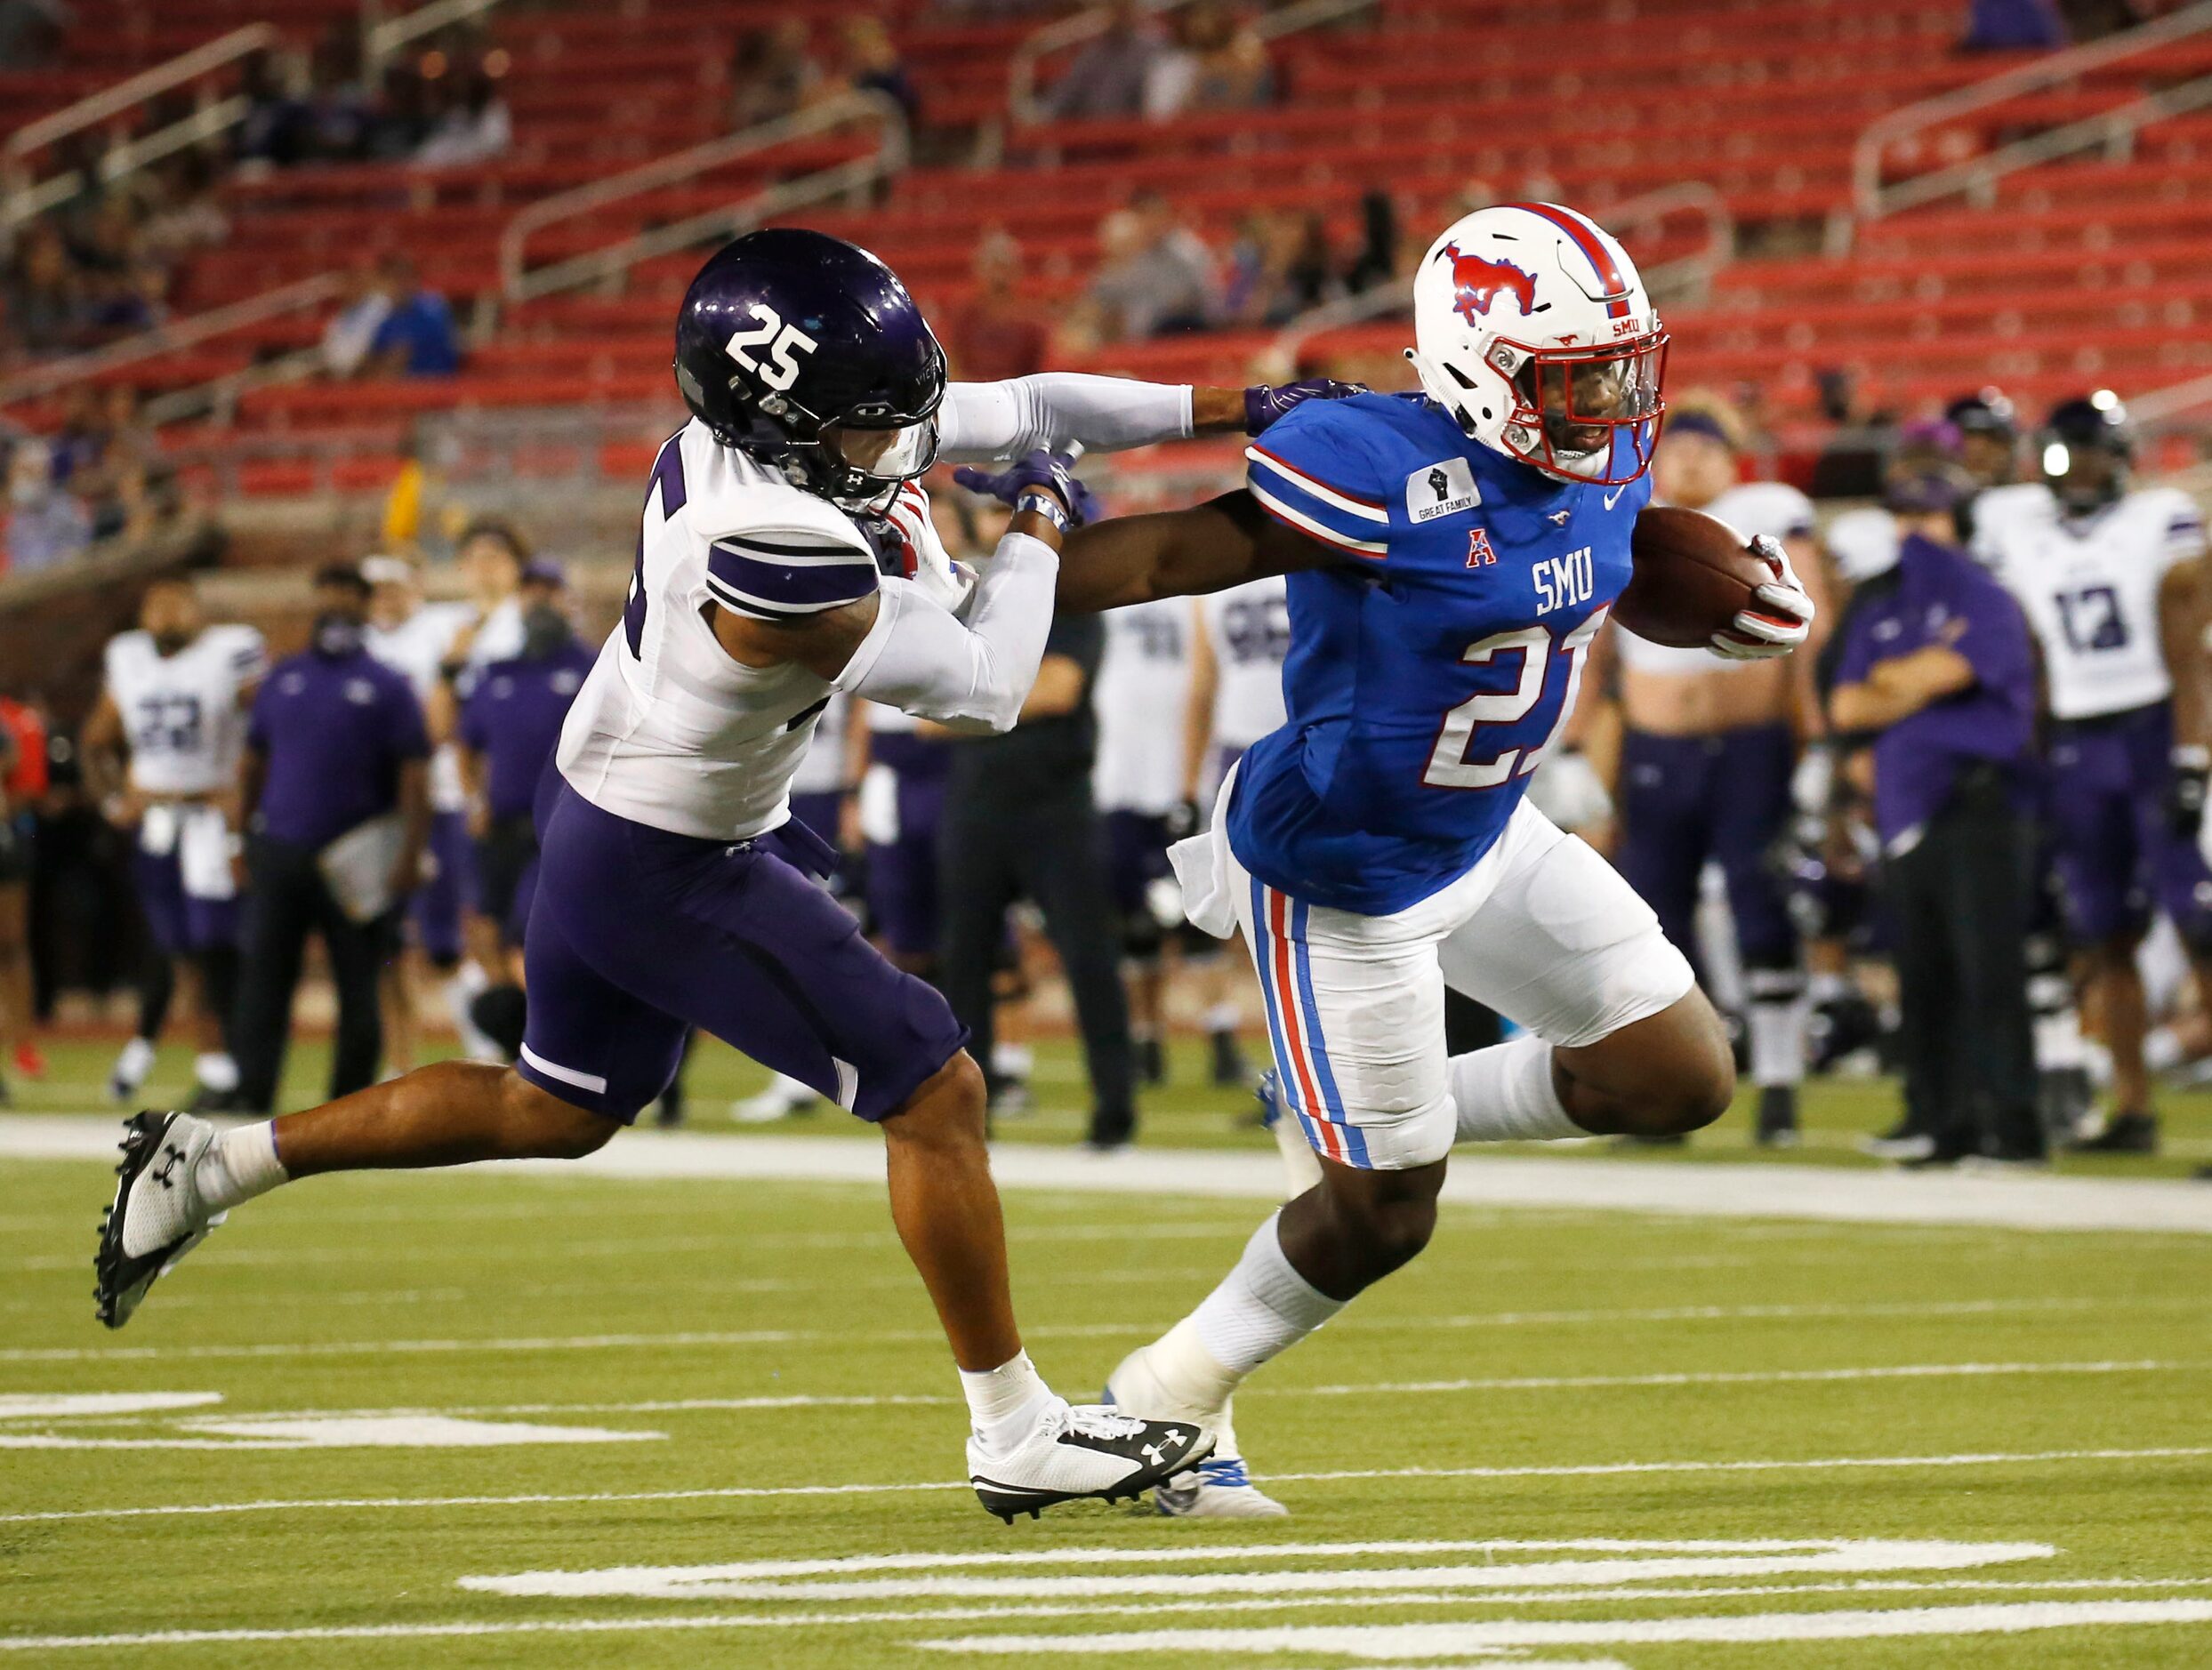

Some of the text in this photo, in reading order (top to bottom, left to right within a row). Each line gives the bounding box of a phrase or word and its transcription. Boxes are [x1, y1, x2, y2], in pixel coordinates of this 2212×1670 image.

[725, 304, 818, 391] 25
[1613, 318, 1639, 337] SMU
[1419, 496, 1472, 520] GREAT FAMILY
[1532, 546, 1594, 616] SMU
[1421, 599, 1613, 792] 21
